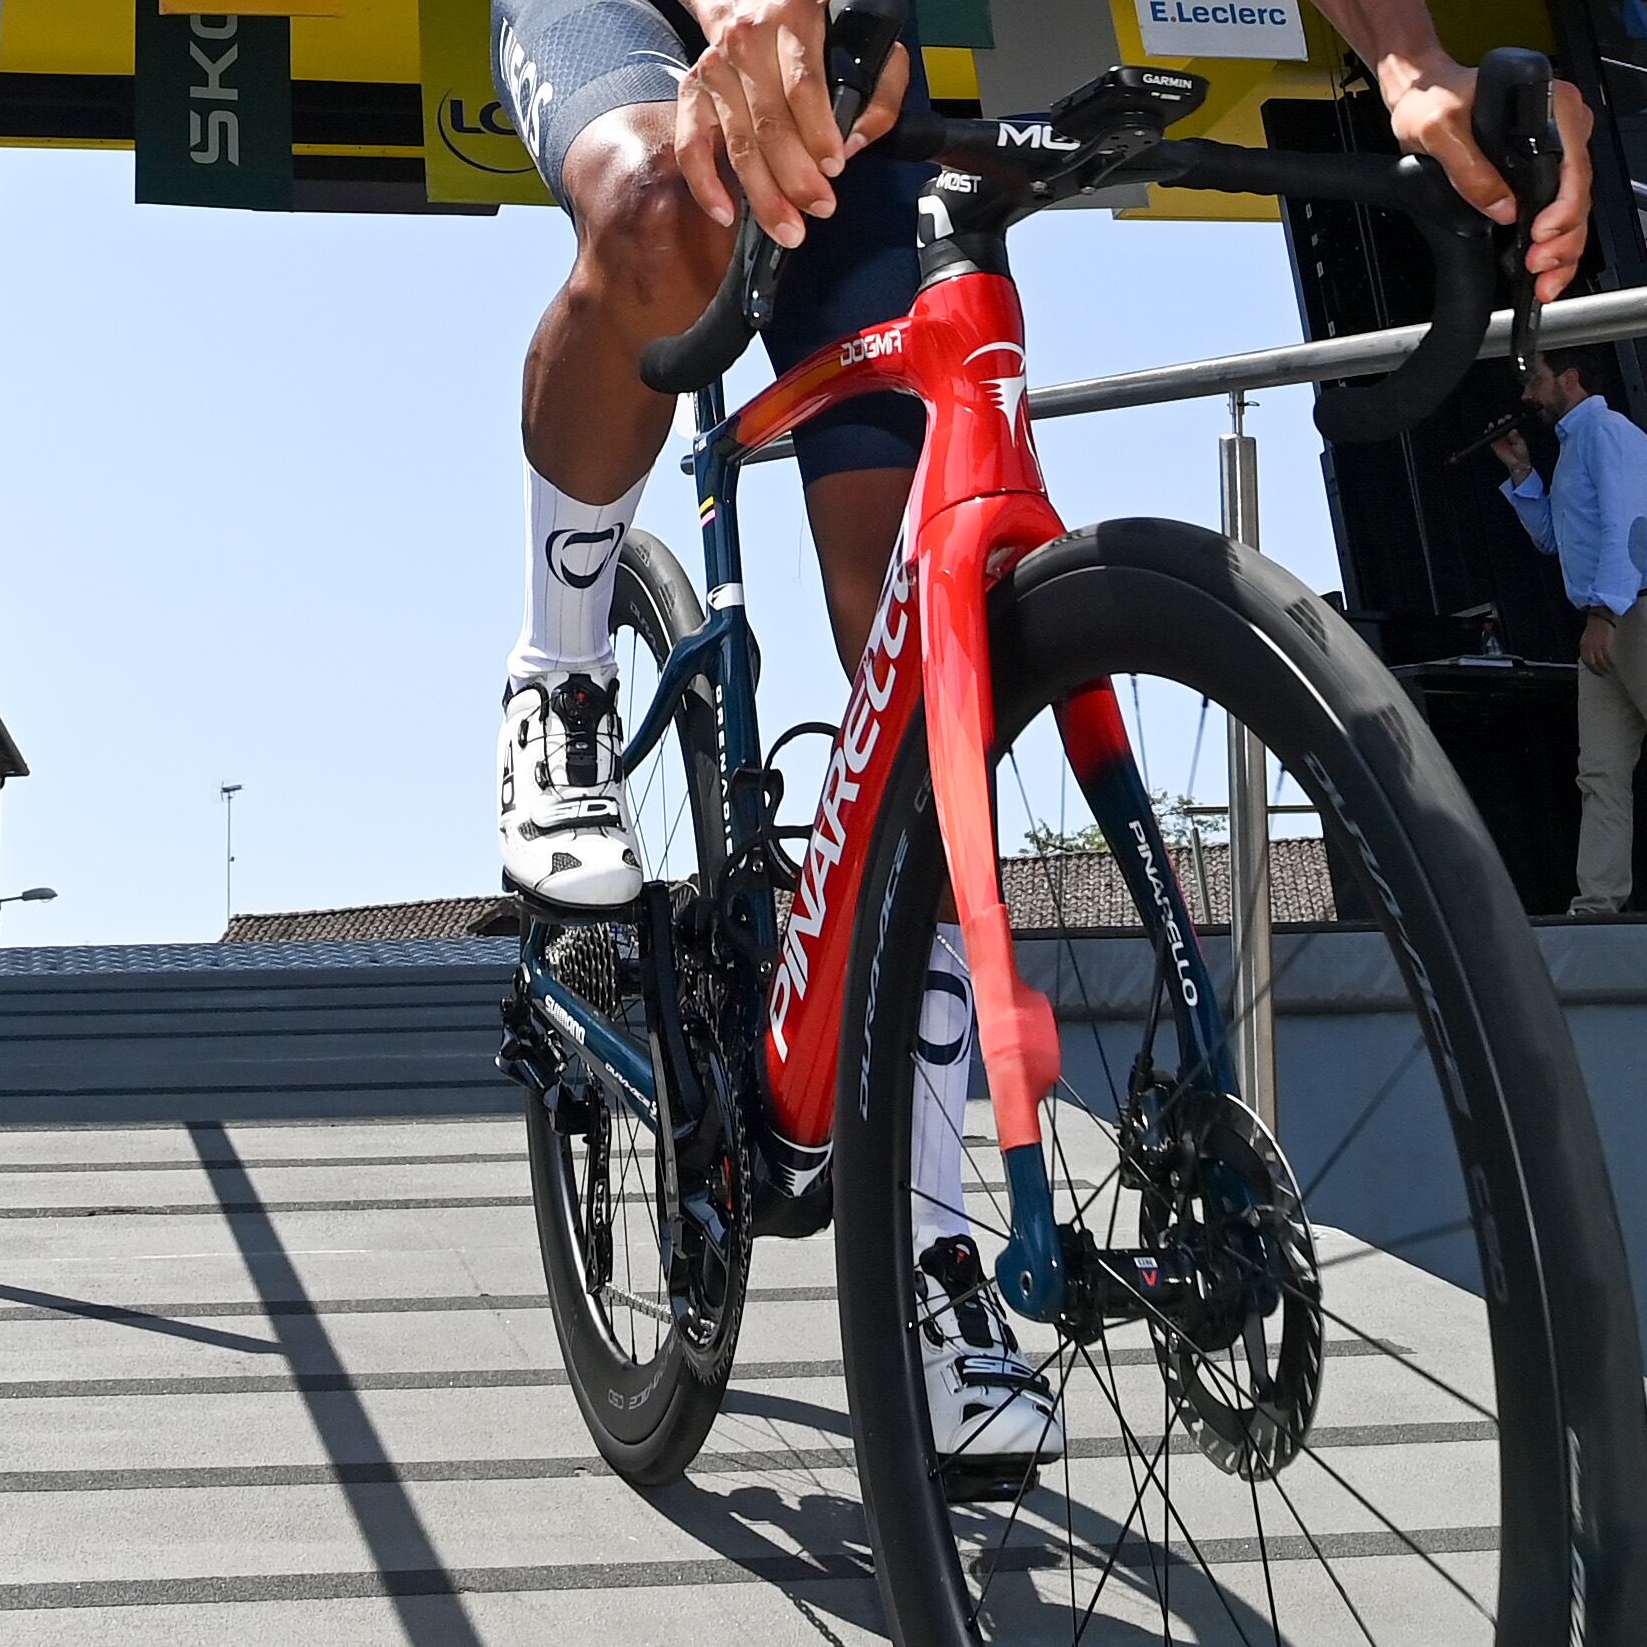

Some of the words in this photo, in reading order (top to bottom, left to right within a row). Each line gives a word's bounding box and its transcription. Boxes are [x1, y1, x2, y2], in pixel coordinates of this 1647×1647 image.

[1149, 0, 1287, 26] E.Leclerc
[1142, 73, 1193, 90] GARMIN
[449, 99, 518, 136] LC
[936, 169, 983, 193] MOST
[1128, 819, 1199, 1008] PINARELLO
[859, 828, 909, 1122] DURA-ACE
